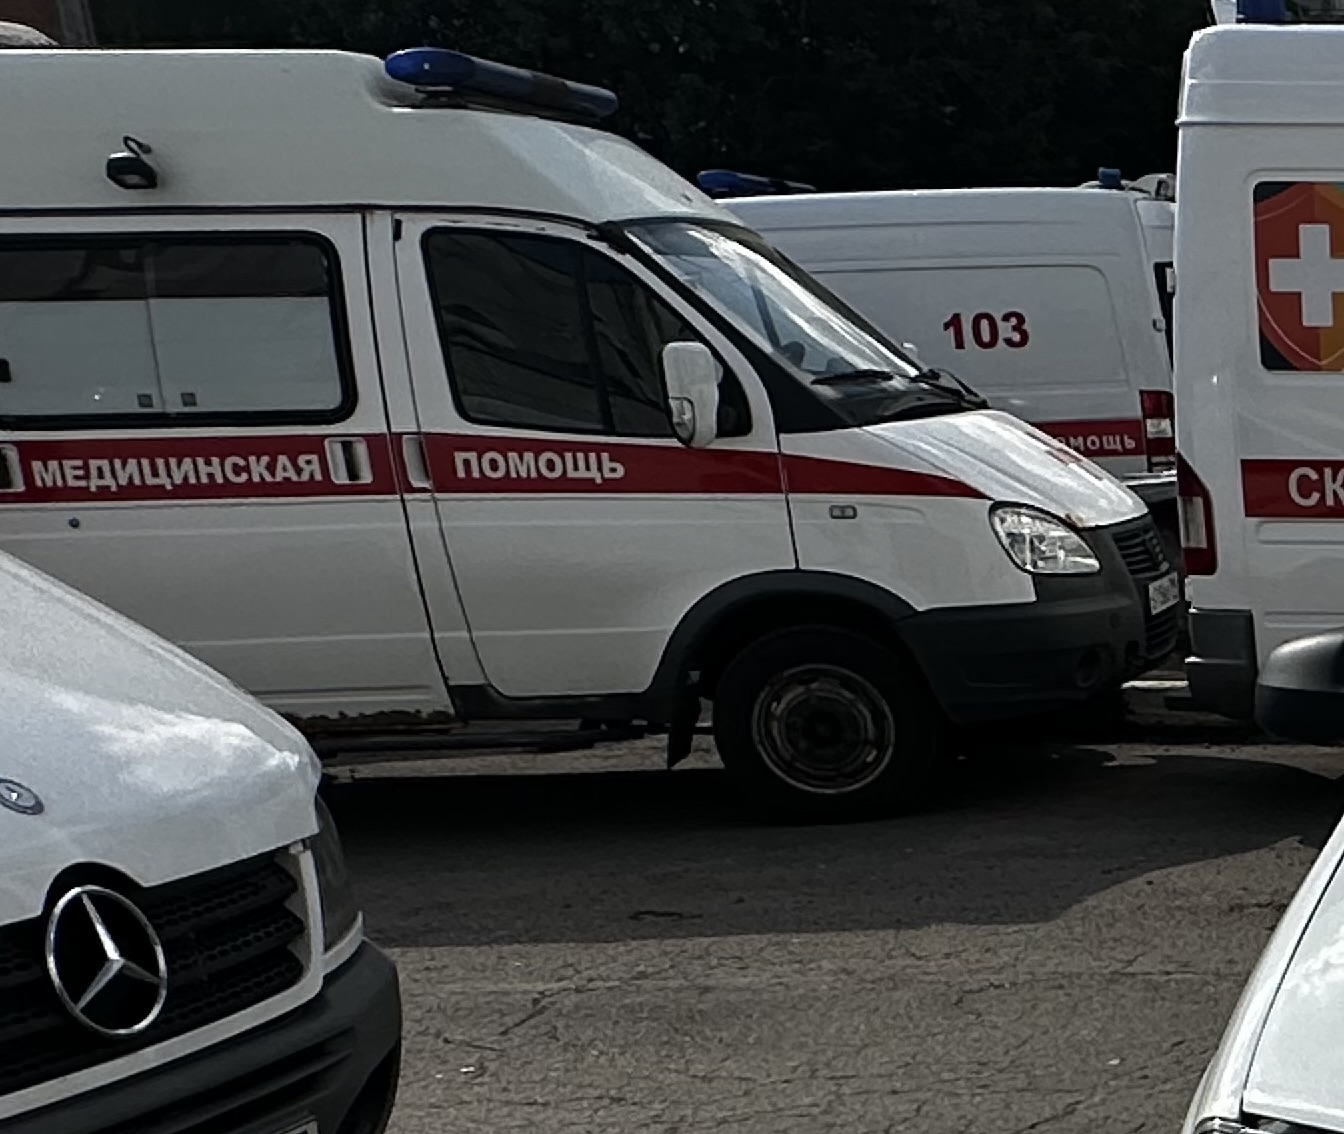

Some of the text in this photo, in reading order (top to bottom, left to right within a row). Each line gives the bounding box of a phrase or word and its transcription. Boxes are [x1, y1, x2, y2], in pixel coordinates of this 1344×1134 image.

[943, 311, 1029, 350] 103
[31, 451, 626, 491] МЕДИЦИНСКАЯ ПОМОЩЬ
